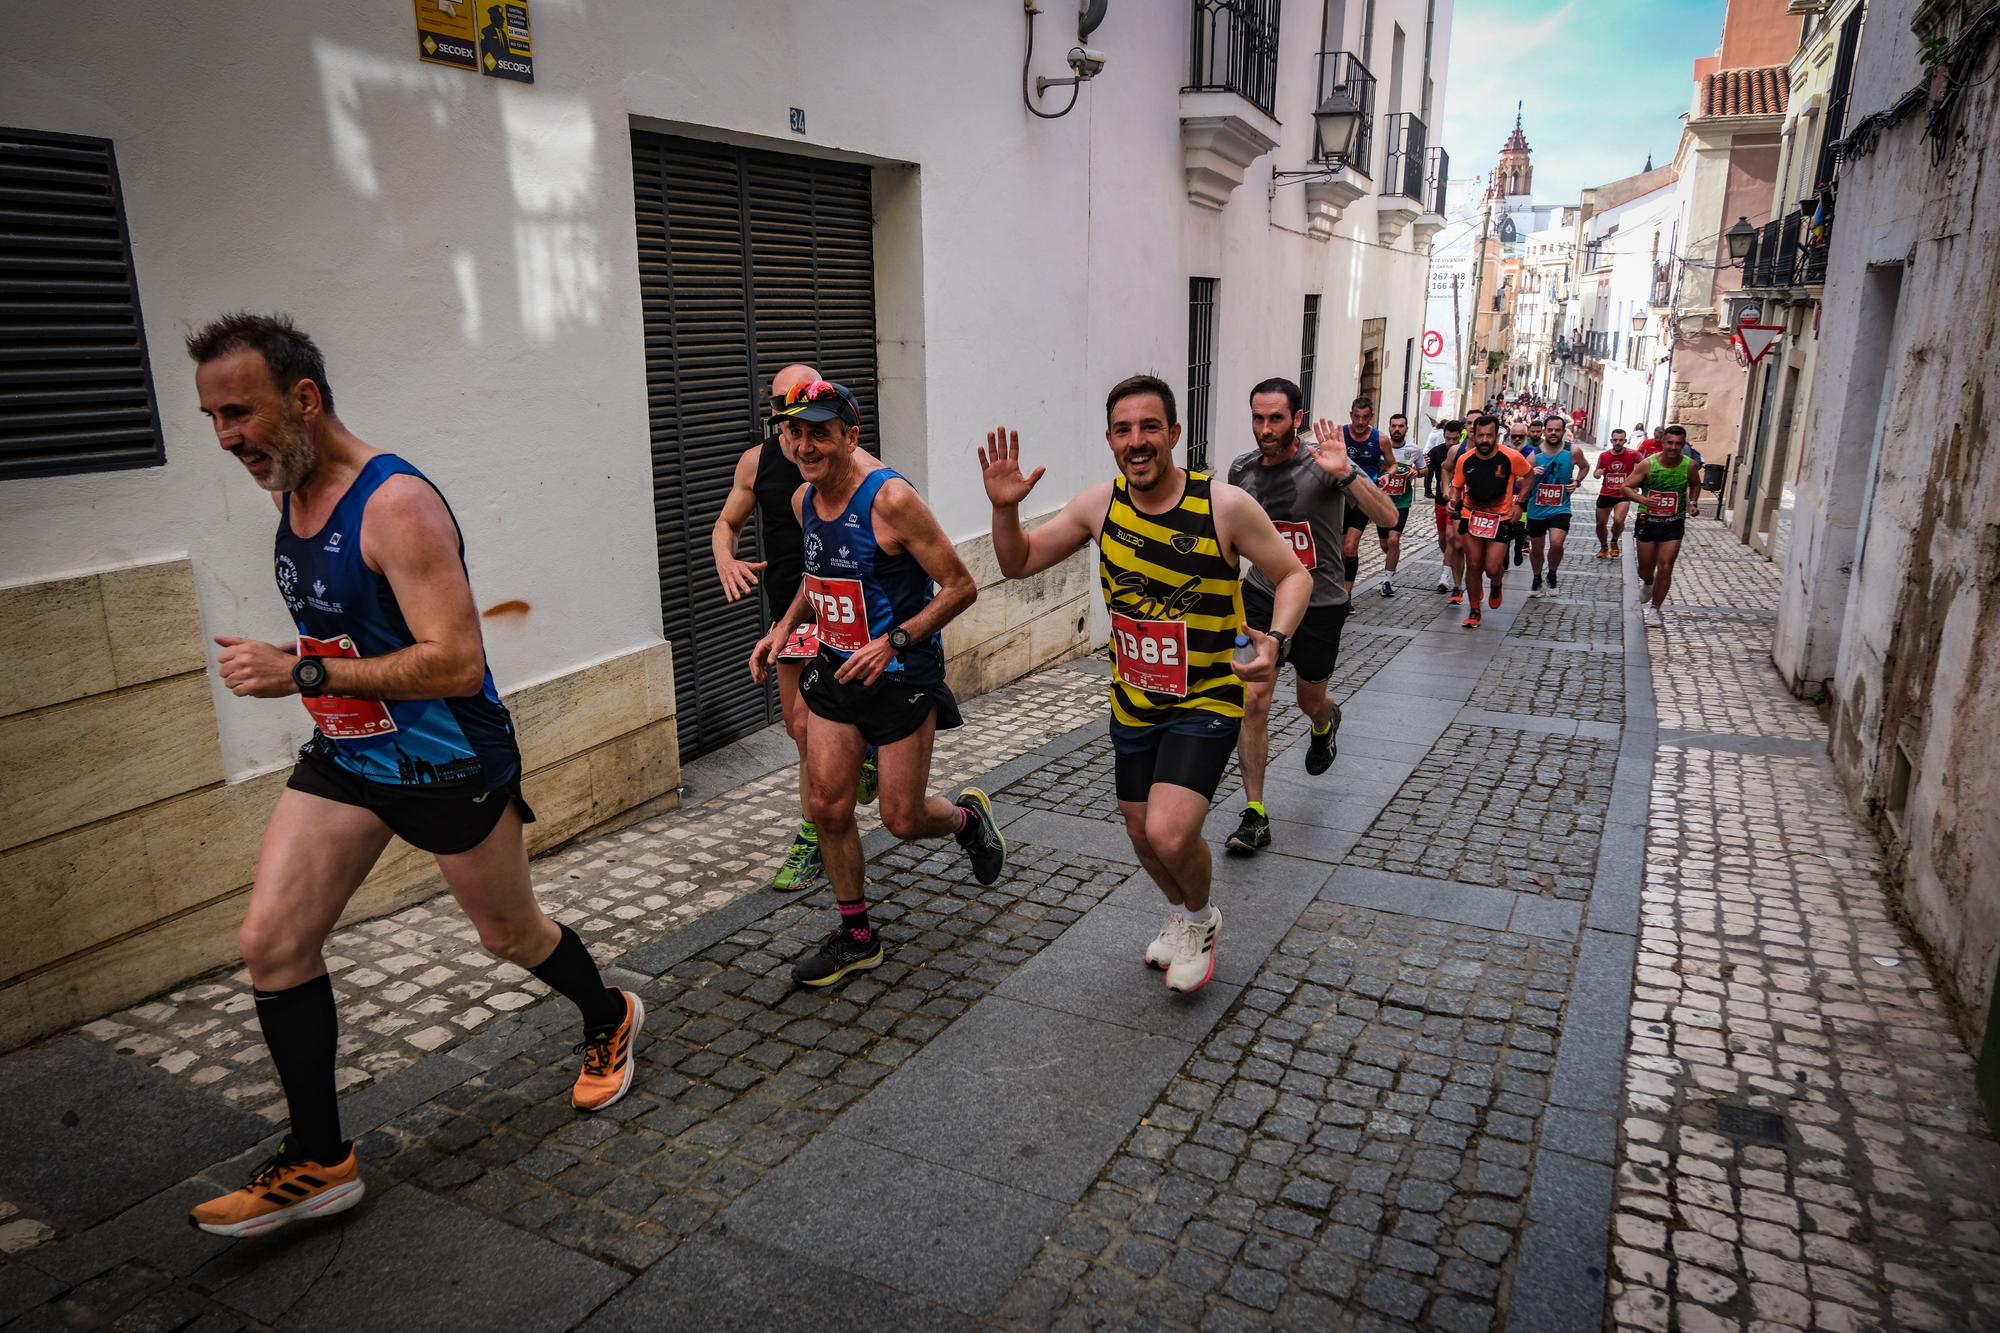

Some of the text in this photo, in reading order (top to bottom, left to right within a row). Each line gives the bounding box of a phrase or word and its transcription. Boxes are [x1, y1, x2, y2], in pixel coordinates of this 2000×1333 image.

[438, 43, 474, 59] SECOEX
[498, 59, 531, 74] SECOEX
[791, 110, 805, 132] 34
[1433, 272, 1448, 281] 267
[1432, 282, 1447, 290] 166
[1538, 488, 1561, 498] 1406
[1473, 516, 1495, 529] 1122
[1117, 629, 1179, 666] 1382
